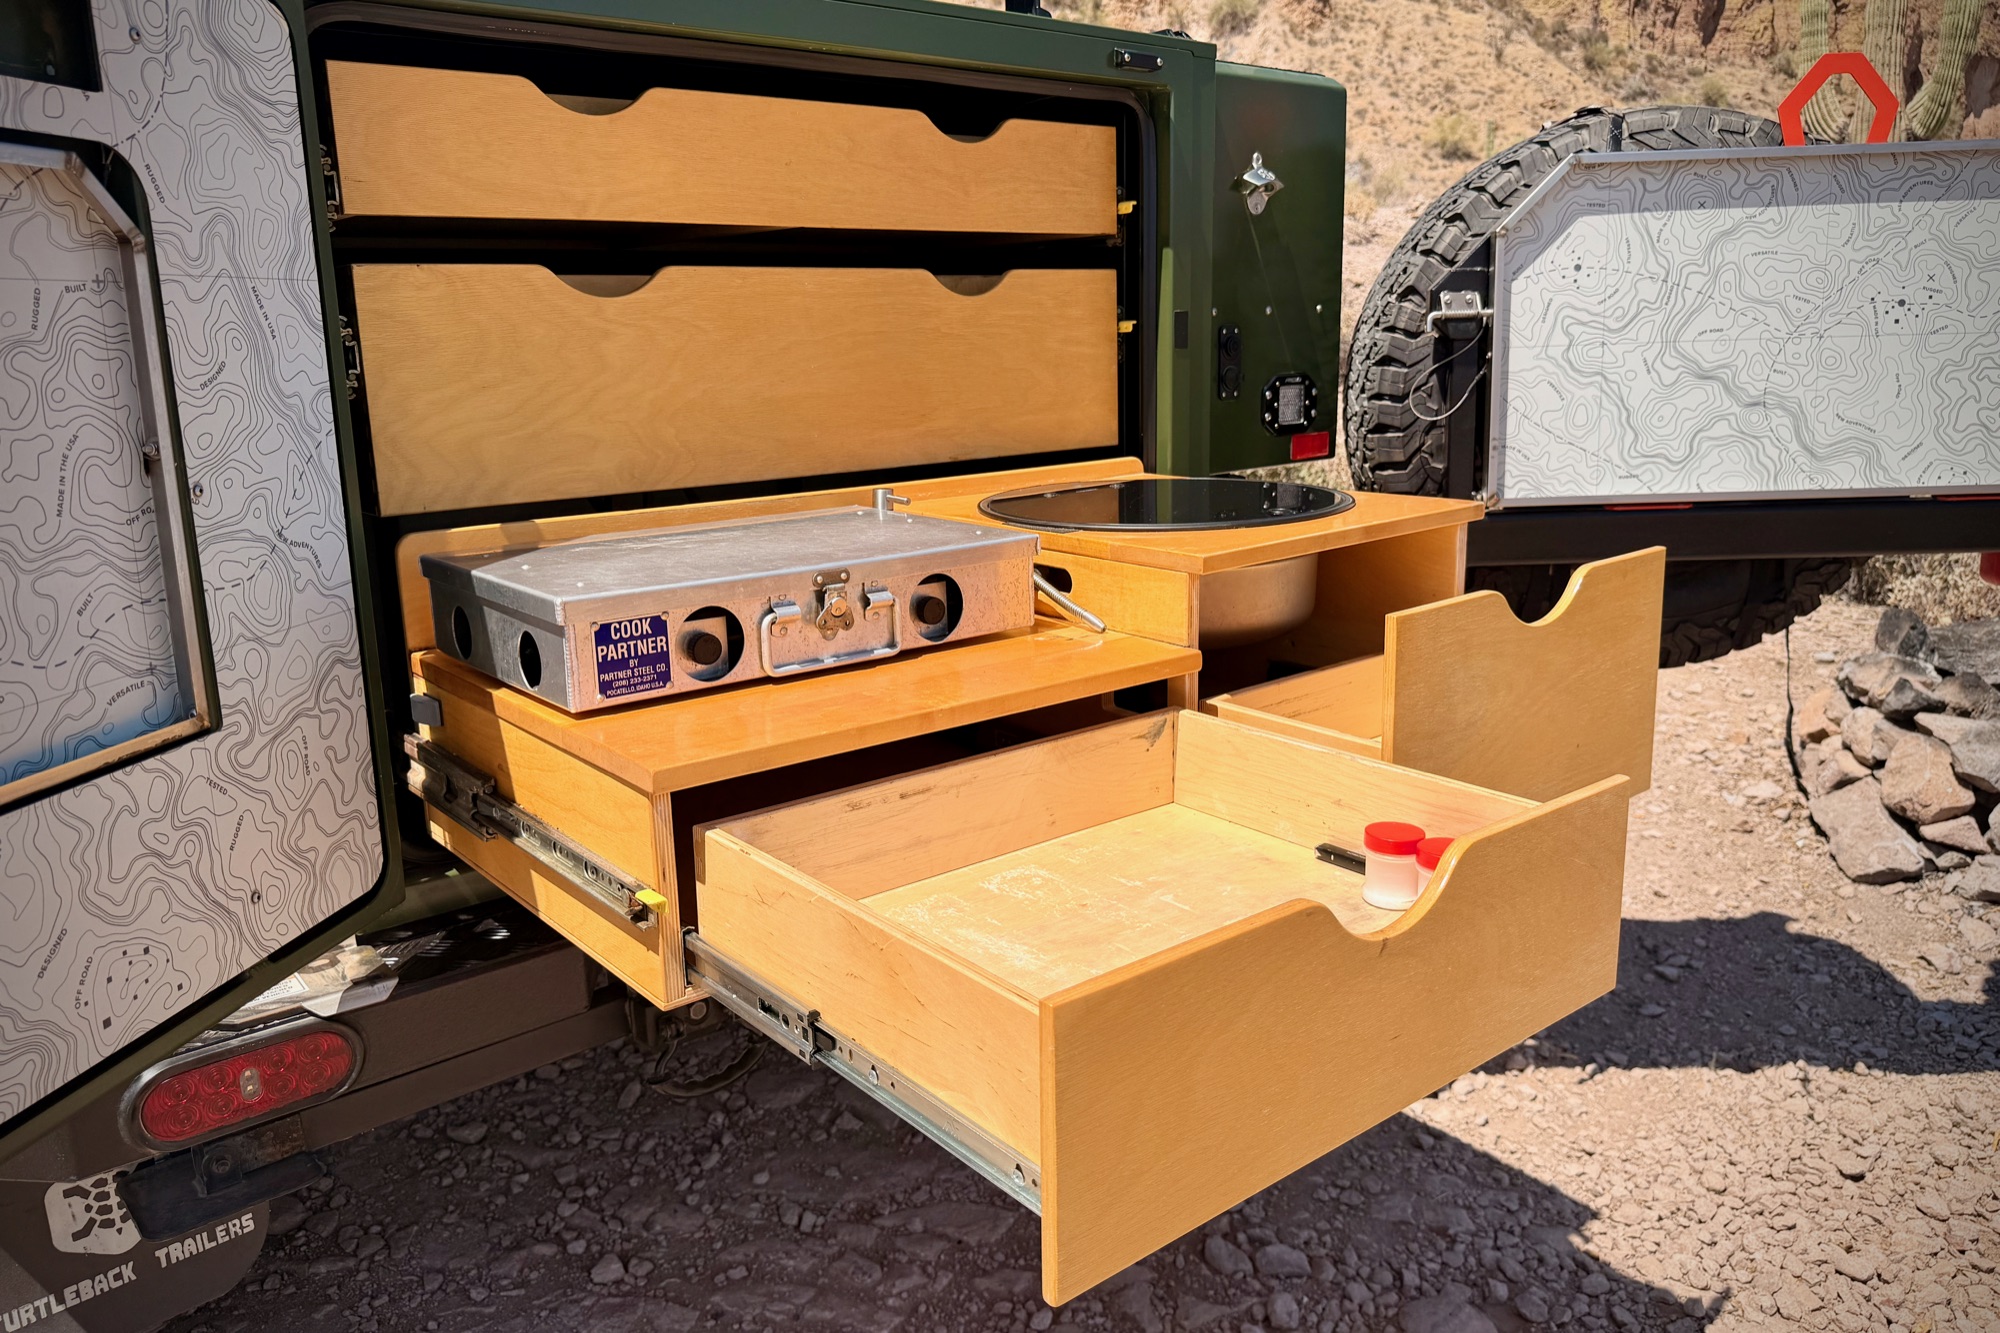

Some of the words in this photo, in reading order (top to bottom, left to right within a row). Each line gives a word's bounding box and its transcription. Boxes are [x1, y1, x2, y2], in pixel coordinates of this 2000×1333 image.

[145, 163, 165, 204] RUGGED
[1693, 172, 1707, 180] BUILT
[1786, 167, 1799, 193] DESIGNED
[1832, 174, 1846, 194] RUGGED
[1902, 180, 1934, 199] ADVENTURES
[1954, 206, 1977, 228] VERSATILE
[1841, 222, 1857, 248] VERSATILE
[1913, 239, 1927, 249] BUILT
[1624, 237, 1632, 264] VERSATILE
[1943, 260, 1957, 285] DESIGNED
[64, 283, 87, 294] BUILT
[1607, 287, 1620, 299] ROAD
[1792, 294, 1811, 304] TESTED
[1922, 286, 1943, 294] RUGGED
[31, 287, 41, 331] RUGGED
[250, 286, 265, 310] MADE
[262, 311, 269, 321] IN
[267, 322, 277, 341] USA
[1930, 325, 1949, 336] TESTED
[199, 360, 226, 391] DESIGNED
[1772, 368, 1787, 376] BUILT
[1845, 420, 1877, 435] ADVENTURES
[65, 433, 80, 452] USA
[60, 452, 69, 473] THE
[59, 475, 66, 486] IN
[56, 488, 65, 518] MADE
[125, 514, 140, 526] OFF
[276, 529, 288, 544] NEW
[289, 540, 322, 569] ADVENTURES
[76, 592, 94, 618] BUILT
[610, 618, 652, 640] COOK
[597, 636, 667, 663] PARTNER
[600, 669, 632, 683] PARTNER
[634, 665, 654, 677] STEEL
[656, 663, 668, 673] CO.
[629, 658, 639, 668] BY
[106, 680, 146, 707] VERSATILE
[636, 683, 651, 692] IDAHO
[301, 735, 309, 751] OFF
[303, 753, 311, 776] ROAD
[205, 776, 228, 796] TESTED
[229, 814, 244, 852] RUGGED
[37, 928, 67, 979] DESIGNED
[74, 989, 83, 1010] OFF
[79, 956, 93, 986] ROAD
[154, 1212, 255, 1269] TRAILERS
[0, 1261, 137, 1333] URTLEBACK
